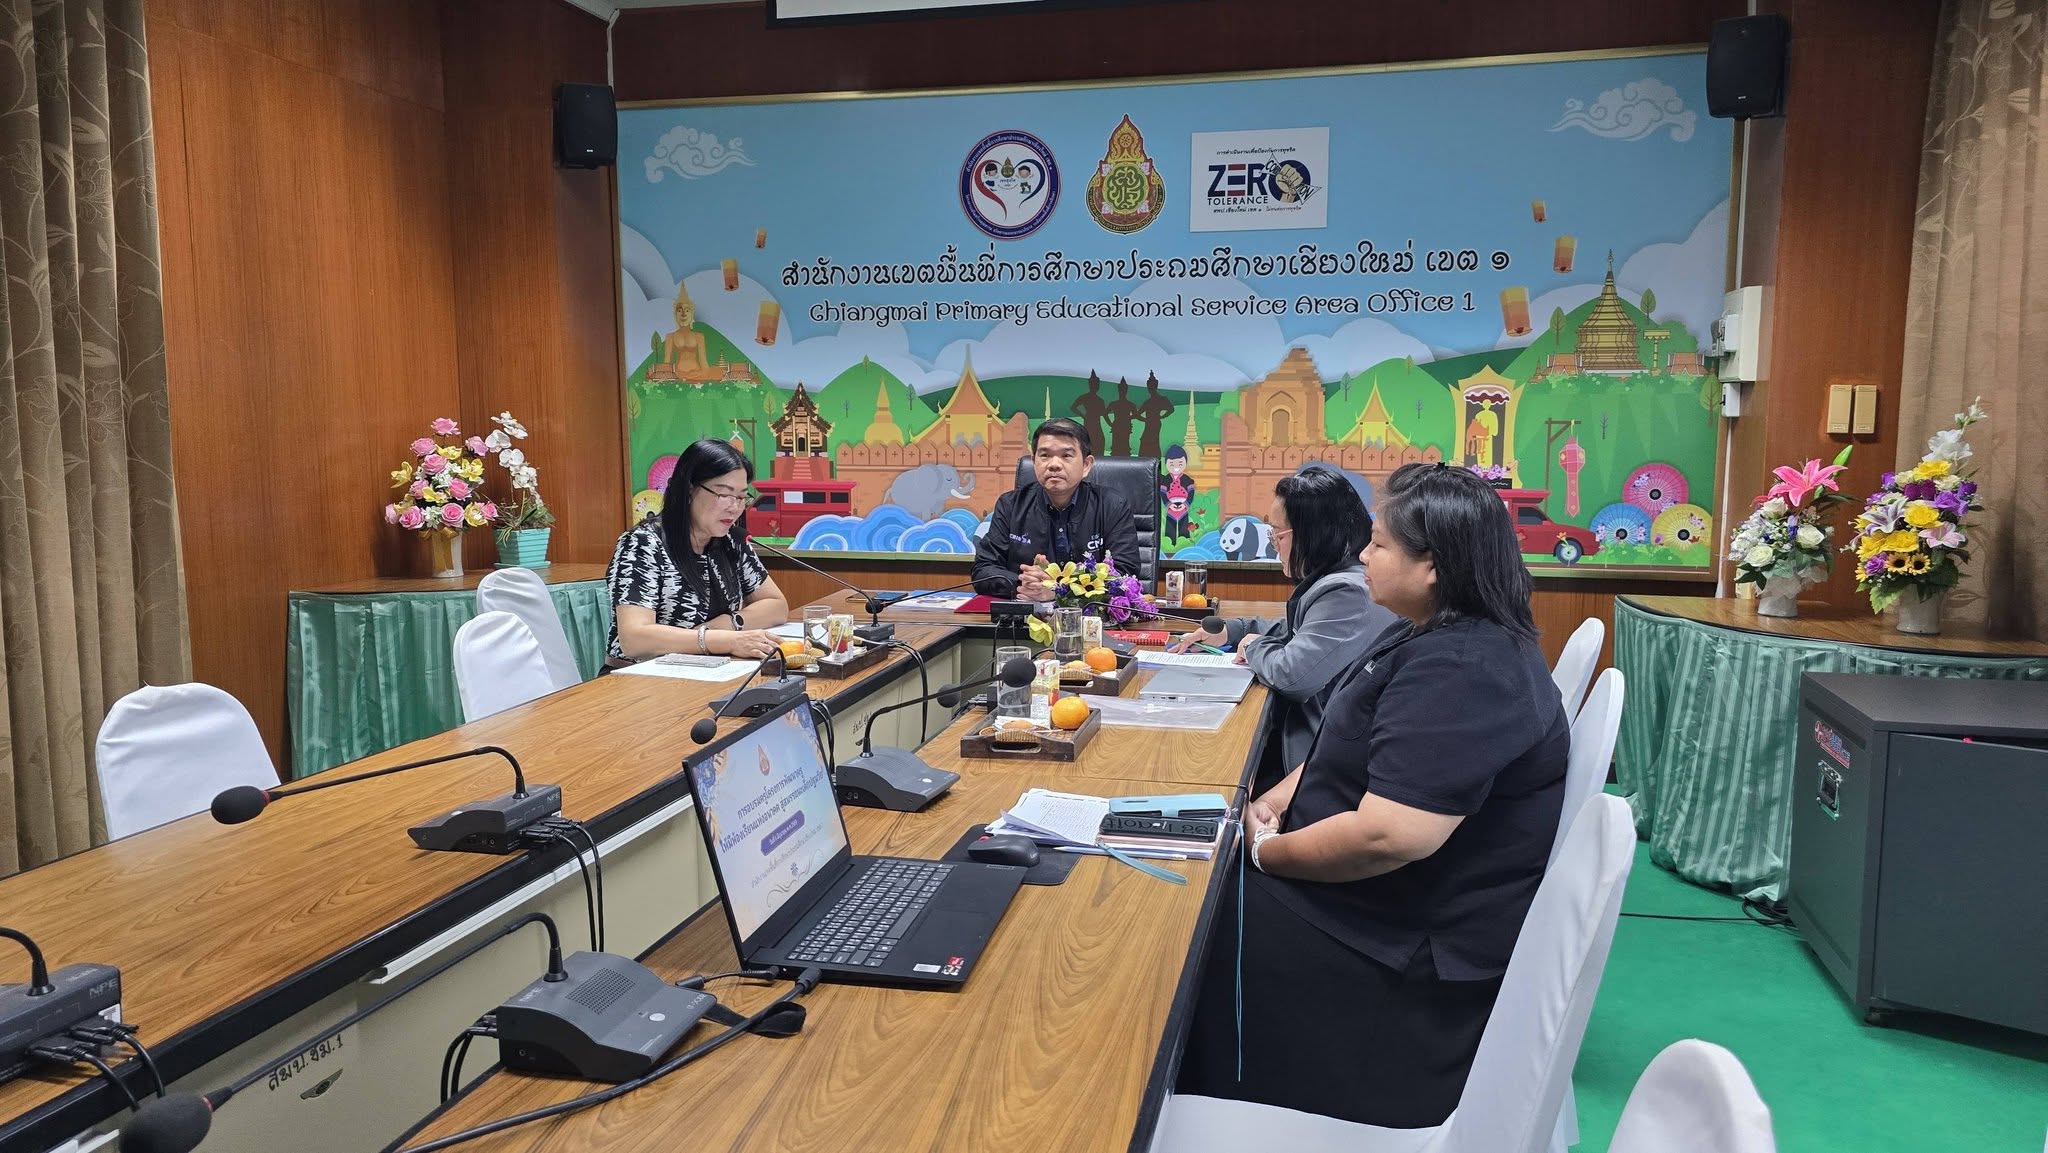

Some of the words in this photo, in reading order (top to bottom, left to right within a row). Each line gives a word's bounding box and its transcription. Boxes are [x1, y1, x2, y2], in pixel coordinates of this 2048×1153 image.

[1207, 160, 1311, 204] ZERO
[1207, 196, 1269, 206] TOLERANCE
[782, 239, 1414, 286] สำนักงานเขตพื้นที่การศึกษาประถมศึกษาเชียงใหม่
[1426, 249, 1479, 273] เขต
[1491, 250, 1510, 271] ๑
[810, 299, 928, 327] Chiangmai
[935, 300, 1029, 326] Primary
[1036, 294, 1184, 319] Educational
[1191, 295, 1287, 317] Service
[1295, 295, 1359, 314] Area
[1367, 288, 1454, 313] Office
[1462, 292, 1476, 311] 1
[89, 978, 118, 998] NPE
[519, 985, 544, 1002] NPE
